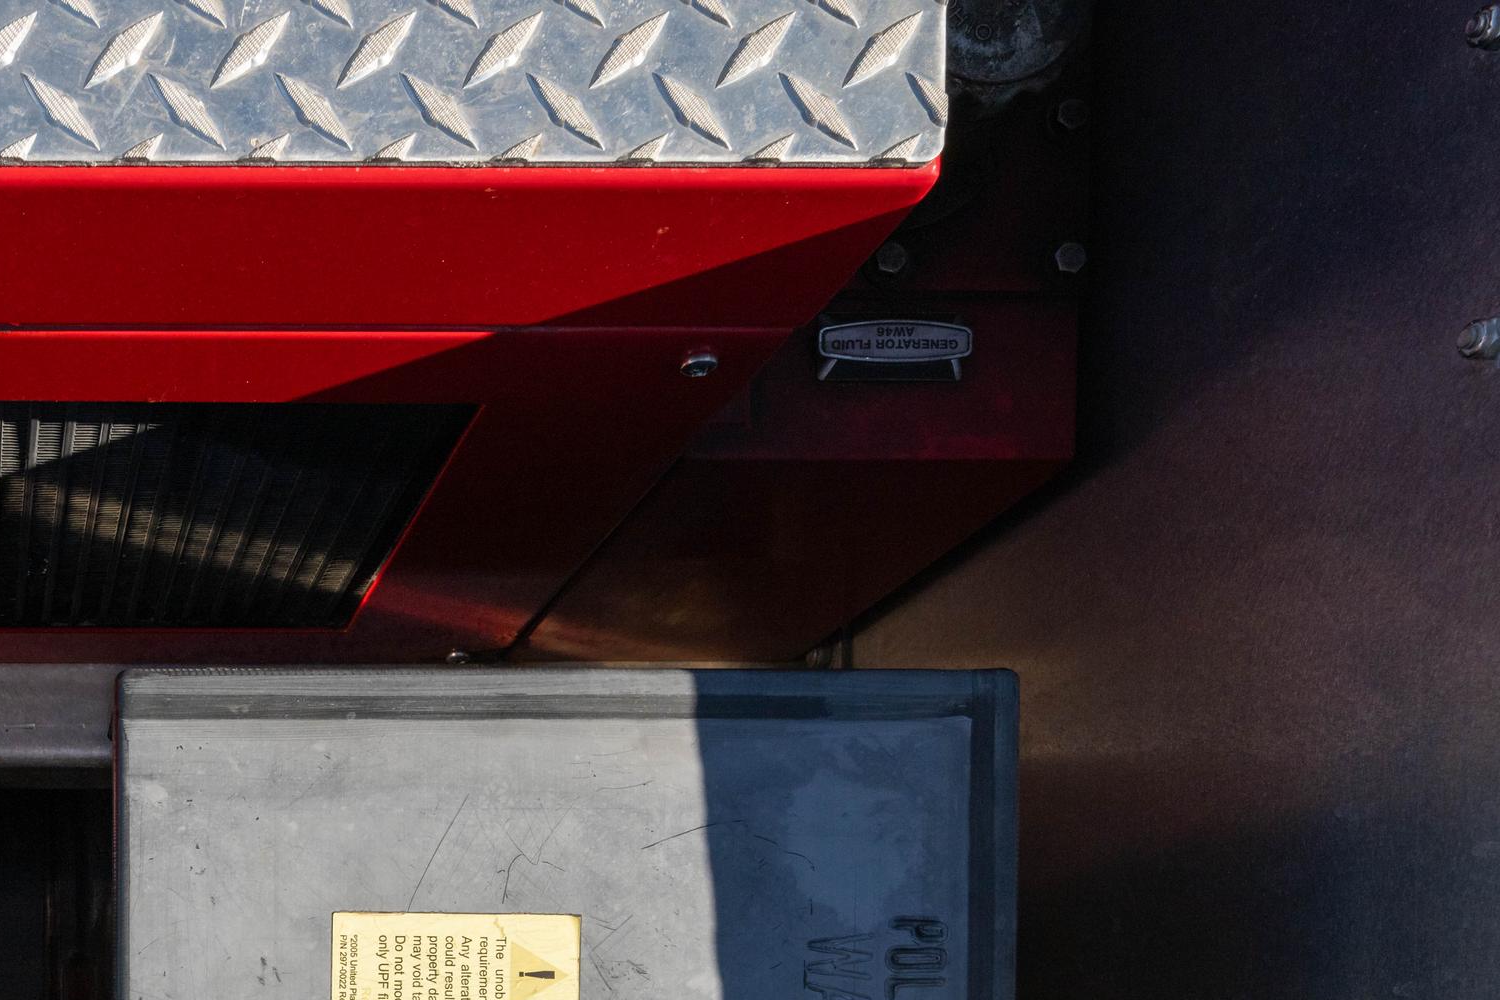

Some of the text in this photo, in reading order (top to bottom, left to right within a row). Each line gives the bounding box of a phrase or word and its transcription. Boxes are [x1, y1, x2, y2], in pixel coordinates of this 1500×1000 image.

[877, 326, 915, 337] AW46
[831, 338, 958, 350] GENERATOR FLUID
[375, 935, 390, 959] only
[394, 936, 406, 952] Do
[410, 936, 421, 960] may
[444, 936, 456, 967] could
[458, 936, 473, 959] Any
[495, 937, 507, 959] The
[339, 952, 347, 989] 297-0022
[394, 957, 405, 975] not
[426, 936, 440, 984] property
[349, 960, 358, 985] United
[378, 963, 389, 989] UPF
[412, 964, 424, 988] void
